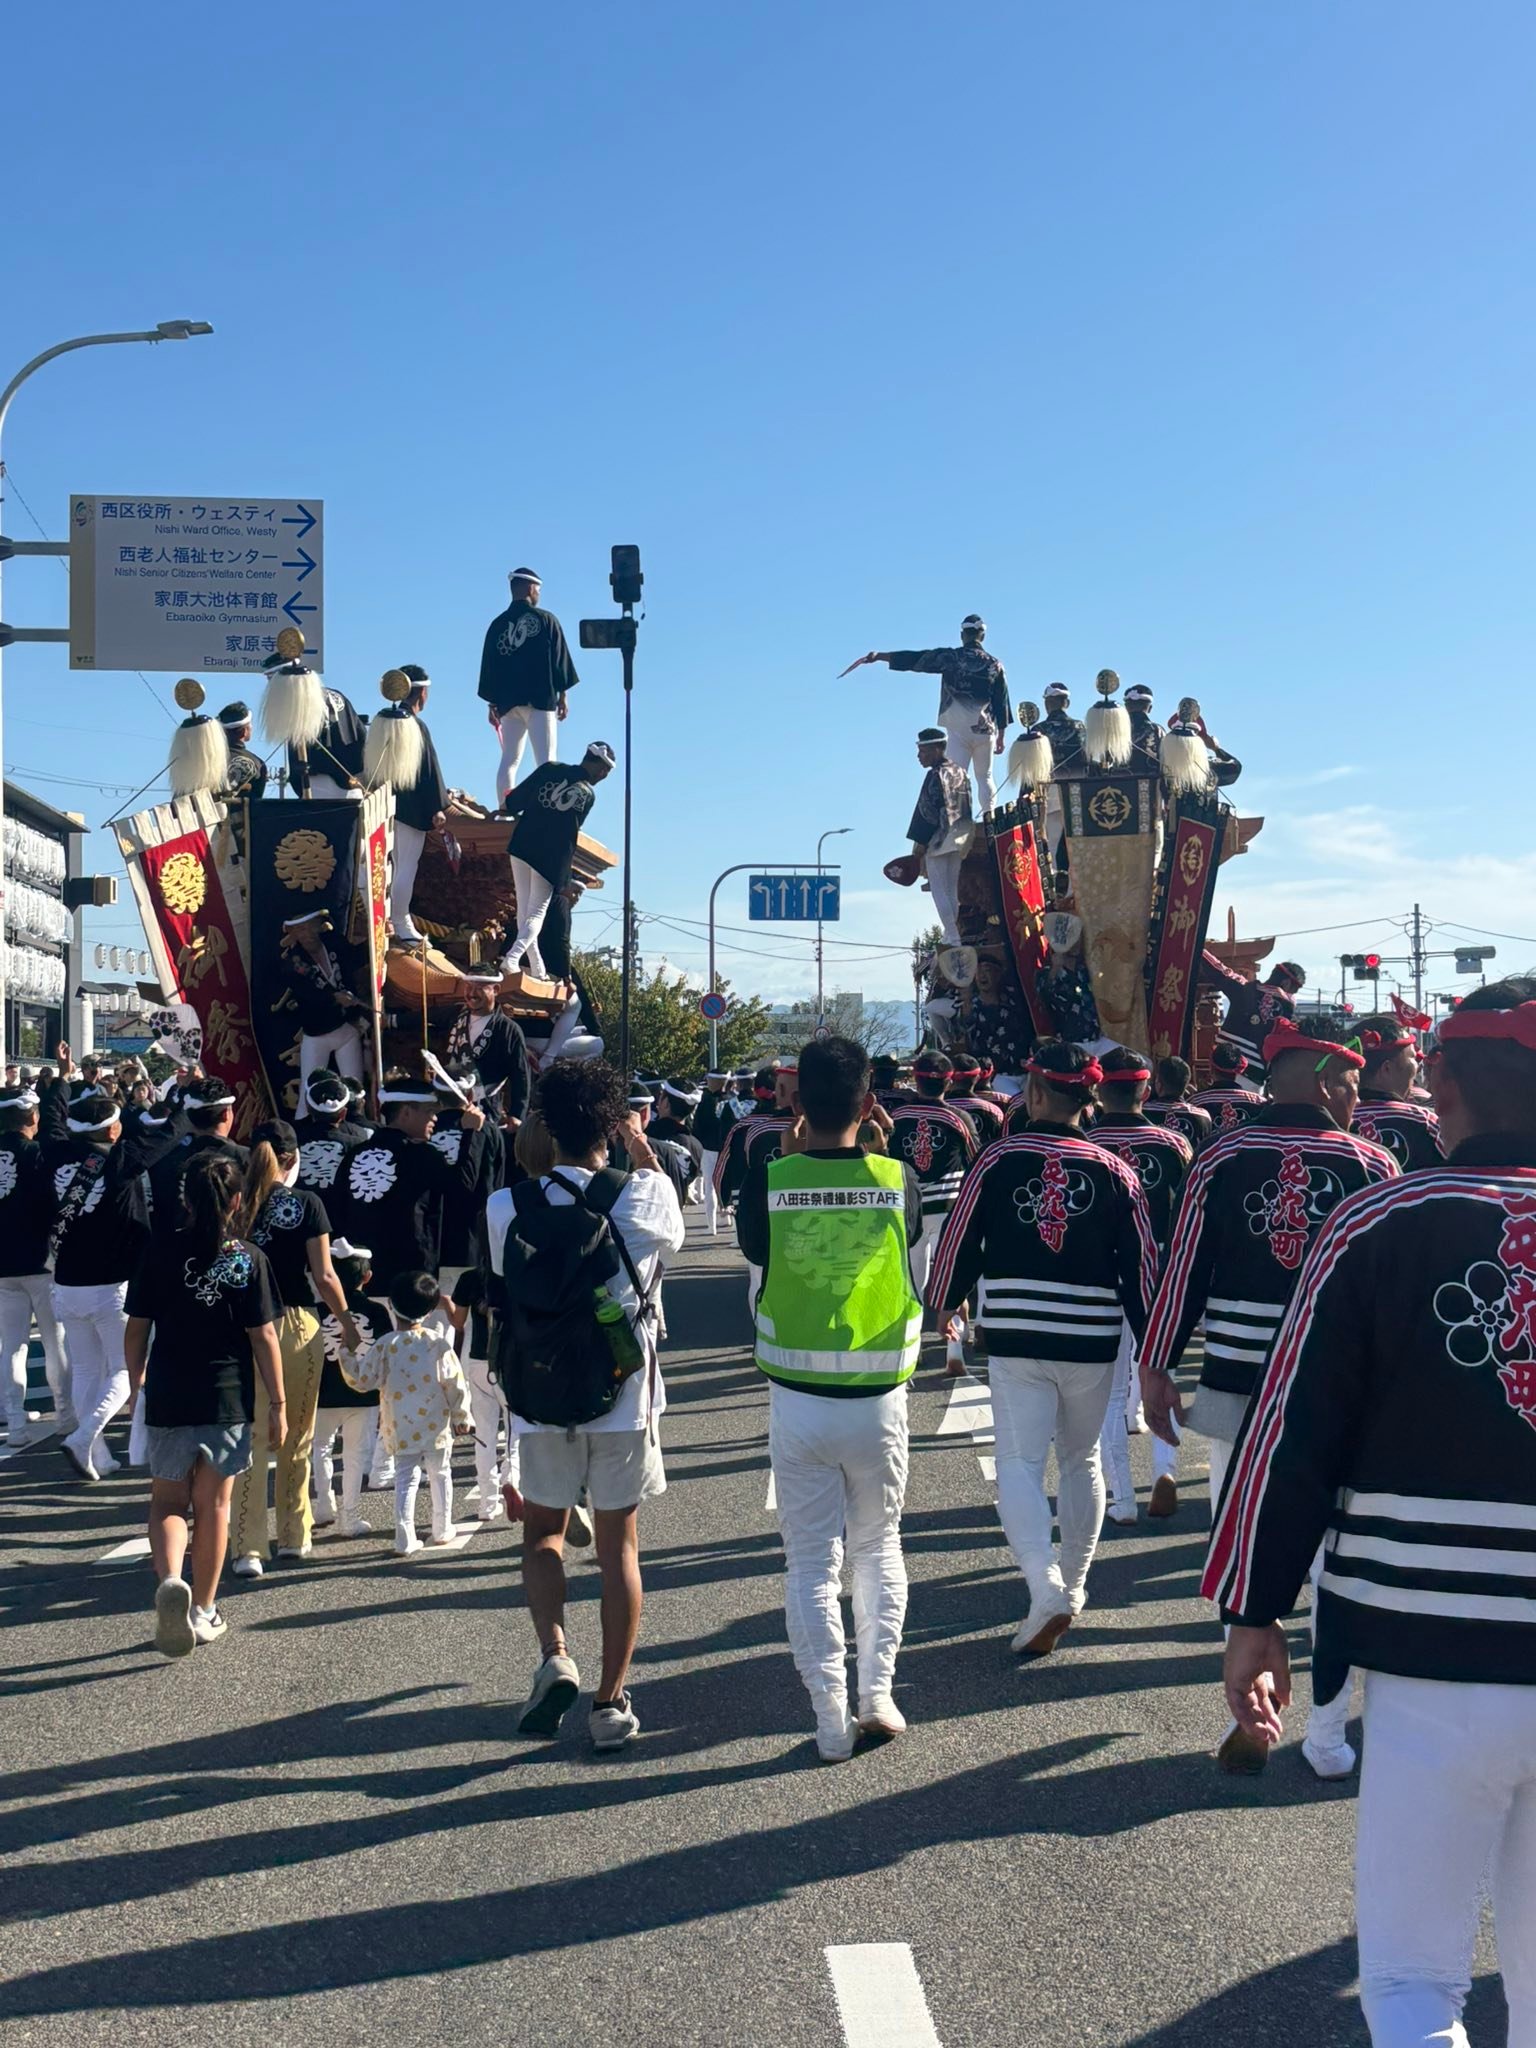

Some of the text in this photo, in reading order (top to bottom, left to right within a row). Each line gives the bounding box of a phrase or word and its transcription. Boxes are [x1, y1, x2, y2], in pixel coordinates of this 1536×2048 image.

[101, 502, 276, 521] 西区役所・ウェスティ
[155, 525, 180, 534] Nishi
[182, 525, 209, 535] Ward
[246, 527, 278, 538] Westy
[119, 546, 278, 564] 西老人福祉センター
[114, 567, 137, 577] Nishi
[139, 568, 169, 578] Senior
[245, 569, 276, 579] Center
[154, 590, 278, 609] 家原大池体育館
[166, 612, 278, 624] Ebaraoike Gymnasium
[225, 635, 277, 652] 家原寺
[203, 656, 239, 668] Ebaraji
